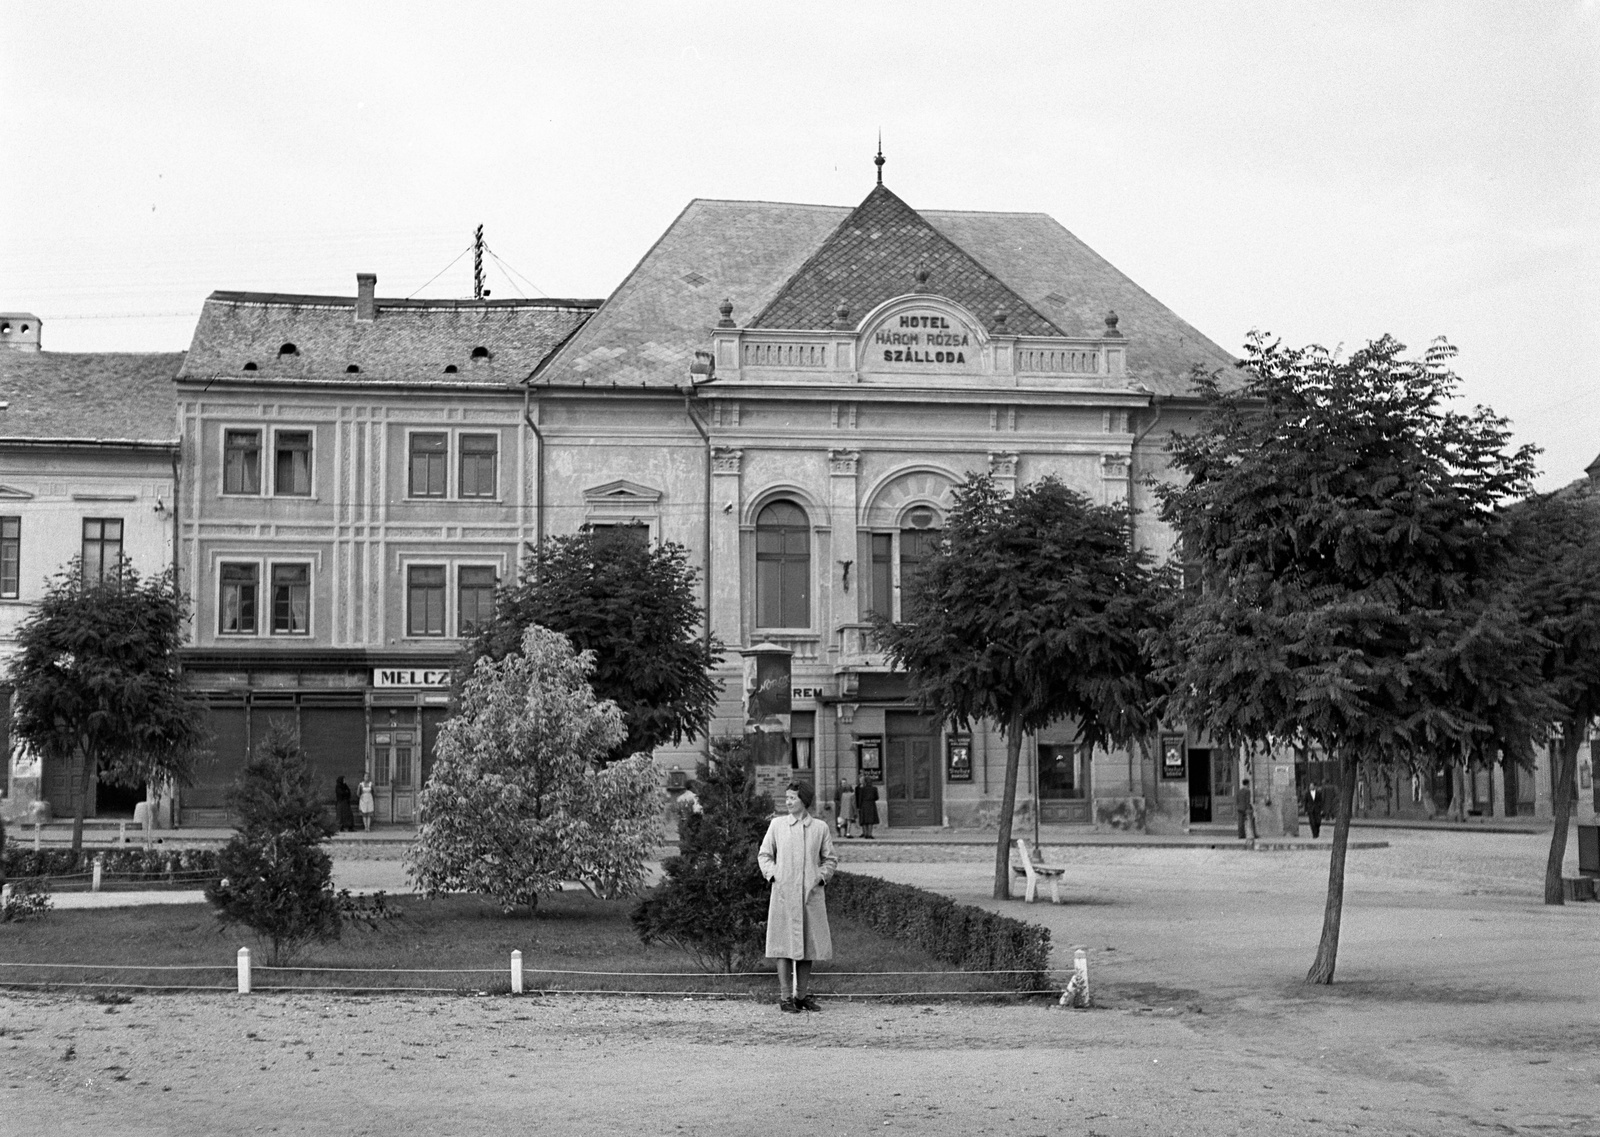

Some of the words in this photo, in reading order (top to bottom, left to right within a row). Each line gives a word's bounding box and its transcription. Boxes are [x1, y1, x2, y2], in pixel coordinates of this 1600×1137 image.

[900, 316, 949, 329] HOTEL
[876, 329, 919, 346] HÁROM
[927, 330, 969, 347] RÓZSA
[884, 347, 965, 364] SZÁLLODA
